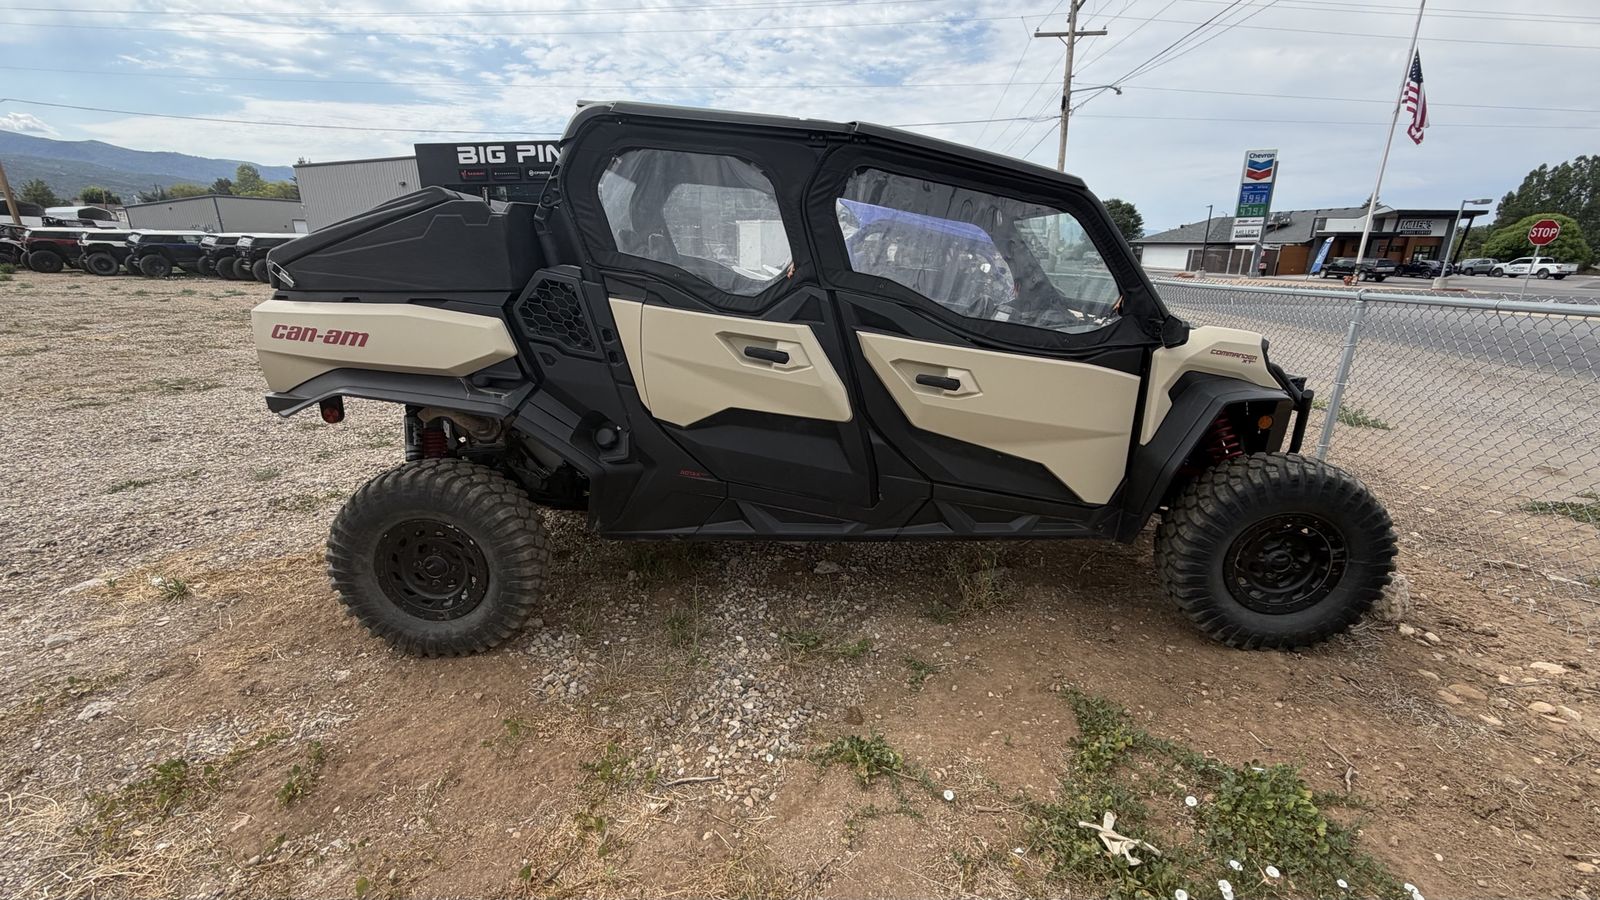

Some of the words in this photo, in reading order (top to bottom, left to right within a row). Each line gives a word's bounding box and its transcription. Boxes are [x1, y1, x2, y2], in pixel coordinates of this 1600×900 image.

[457, 146, 506, 164] BIG
[1530, 228, 1558, 238] STOP
[271, 324, 369, 347] can-am
[1211, 349, 1257, 360] COMMANDER
